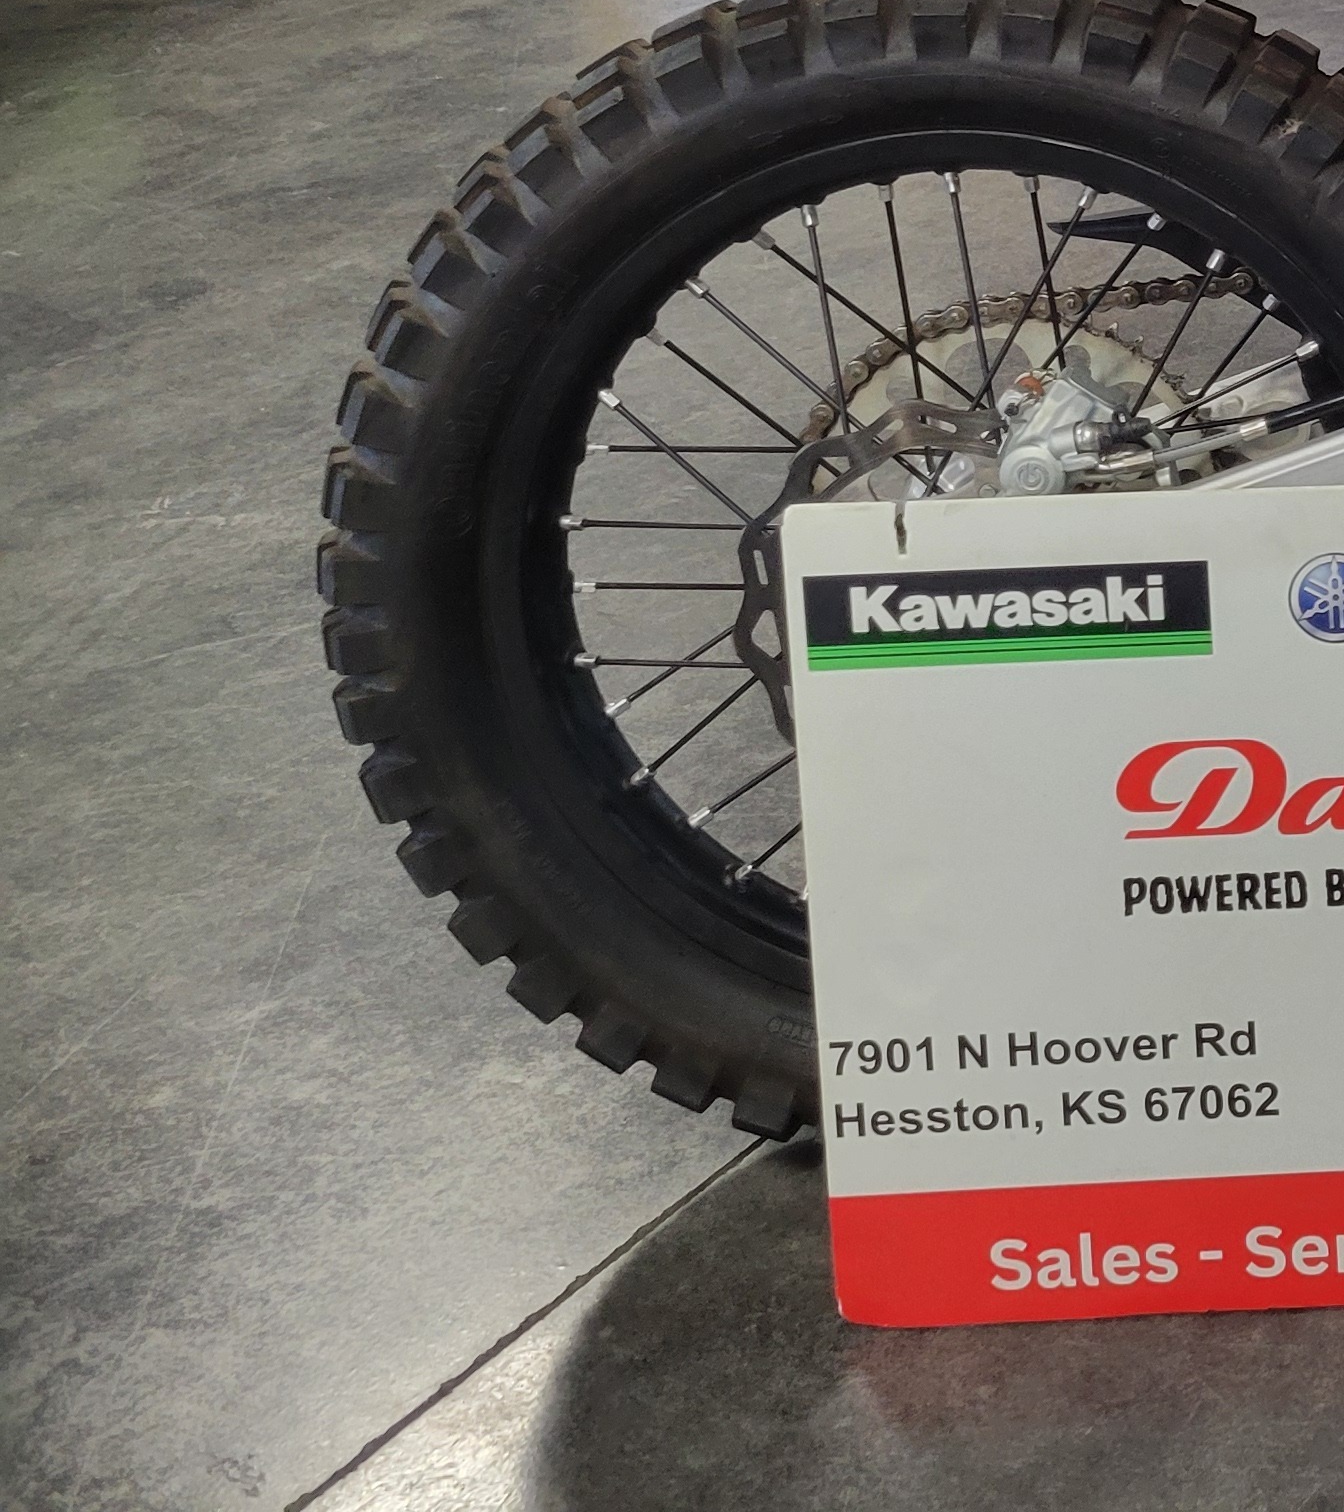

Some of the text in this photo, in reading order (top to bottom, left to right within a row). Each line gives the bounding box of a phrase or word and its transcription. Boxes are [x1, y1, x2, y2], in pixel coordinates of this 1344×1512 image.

[849, 574, 1166, 634] Kawasaki
[1123, 870, 1308, 917] POWERED
[829, 1020, 1258, 1077] 7901 N Hoover Rd
[834, 1082, 1281, 1139] Hesston, KS 67062
[989, 1232, 1180, 1292] Sales
